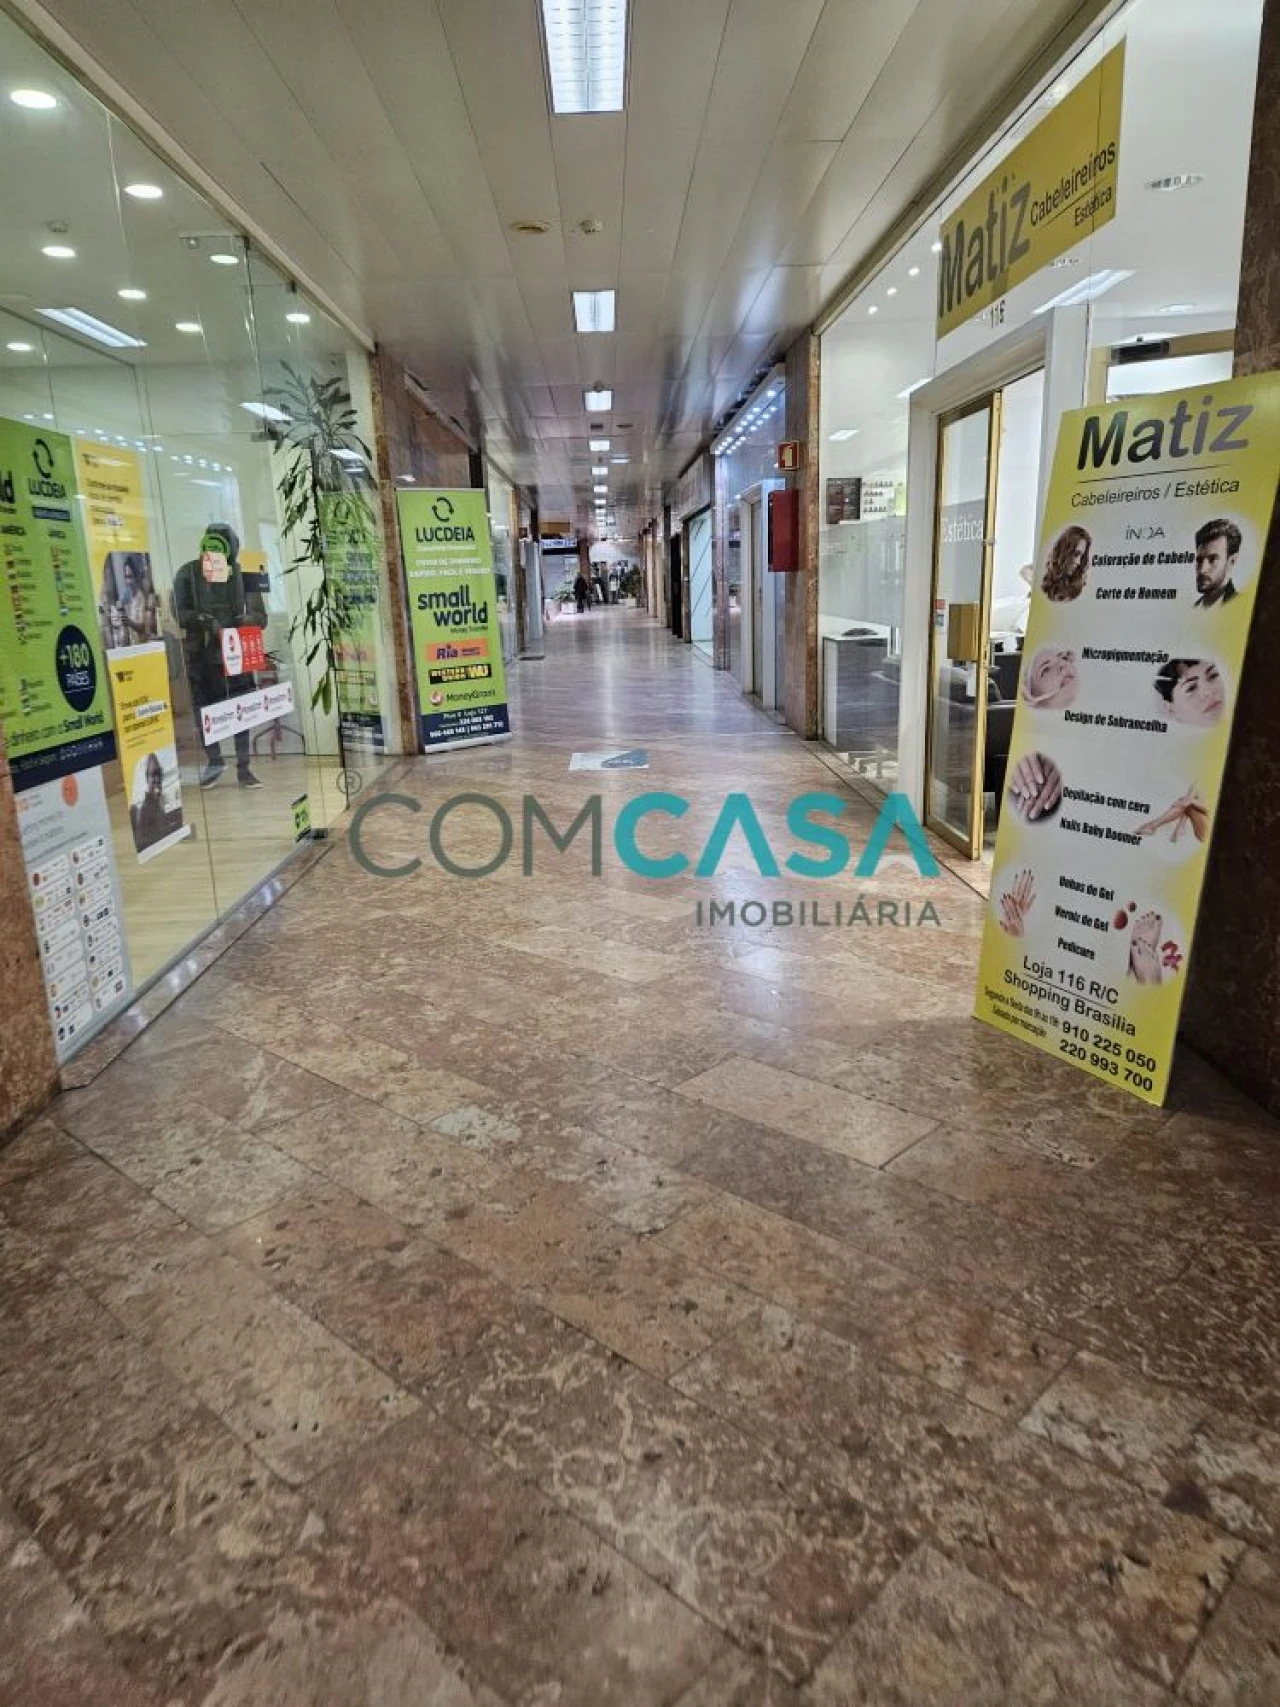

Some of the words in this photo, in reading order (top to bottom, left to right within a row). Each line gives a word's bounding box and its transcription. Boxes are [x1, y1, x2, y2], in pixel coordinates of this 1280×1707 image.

[1030, 141, 1116, 227] Cabeleireiros
[938, 176, 1033, 319] Matiz
[1076, 394, 1254, 472] Matiz
[1070, 485, 1161, 509] Cabeleireiros
[1173, 477, 1241, 500] Estética
[415, 525, 476, 542] LUCDEIA
[1142, 552, 1156, 565] de
[417, 584, 472, 610] small
[1096, 587, 1122, 600] Corte
[1123, 587, 1136, 600] de
[1138, 587, 1178, 600] Homem
[433, 601, 489, 627] world
[436, 644, 459, 660] Ria
[1064, 709, 1094, 725] Design
[1095, 713, 1107, 726] de
[1063, 786, 1105, 805] Depilação
[1107, 796, 1127, 810] com
[1082, 822, 1105, 839] Baby
[1059, 875, 1086, 894] Unhas
[1086, 883, 1098, 897] de
[1098, 887, 1115, 902] Gel
[1081, 914, 1093, 928] de
[1093, 917, 1110, 933] Gel
[1057, 936, 1096, 961] Pedicure
[1003, 968, 1071, 1012] Shopping
[1023, 954, 1054, 980] Loja
[1057, 969, 1085, 991] 116
[1089, 980, 1120, 1005] R/C
[1062, 1020, 1090, 1043] 910
[1092, 1033, 1122, 1057] 225
[1125, 1048, 1157, 1073] 050
[1059, 1038, 1087, 1062] 220
[1089, 1052, 1119, 1076] 993
[1123, 1067, 1153, 1092] 700
